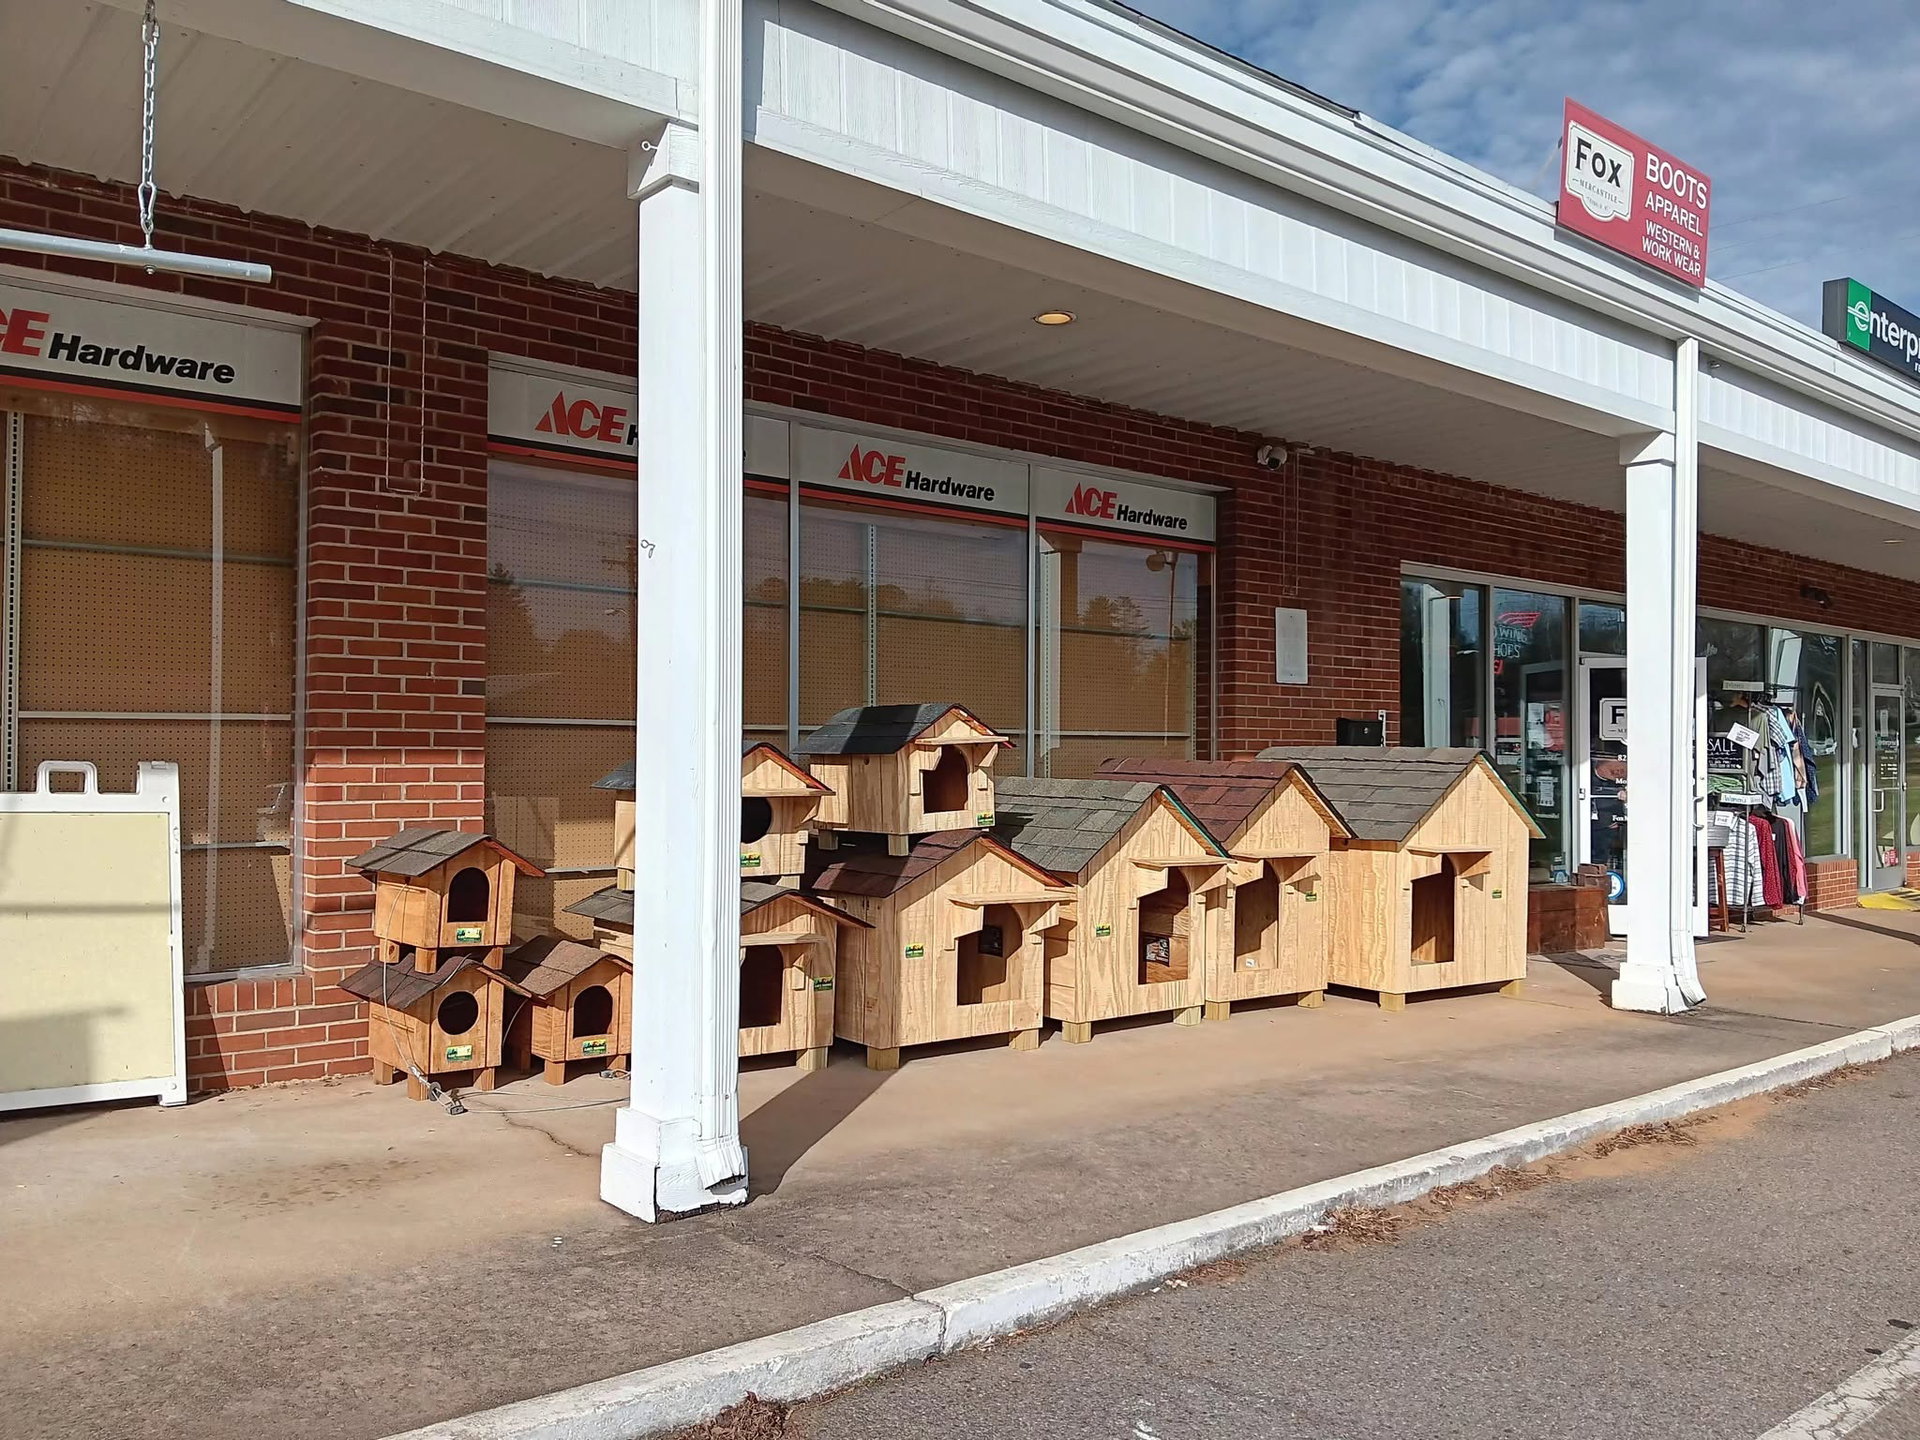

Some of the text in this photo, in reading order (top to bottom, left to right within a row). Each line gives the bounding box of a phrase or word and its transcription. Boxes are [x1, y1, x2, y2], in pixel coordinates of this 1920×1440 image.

[1575, 136, 1622, 189] FOX
[1646, 152, 1708, 209] BOOTS
[1645, 190, 1704, 237] APPAREL
[1642, 235, 1702, 278] WORK WEAR
[1646, 219, 1701, 260] WESTERN &
[1848, 301, 1920, 363] enterp
[48, 332, 237, 385] Hardware
[535, 390, 628, 444] ACE
[837, 442, 996, 502] ACE Hardware
[1065, 482, 1189, 531] ACE Hardware
[1494, 643, 1520, 658] HOES
[1500, 625, 1528, 642] WING
